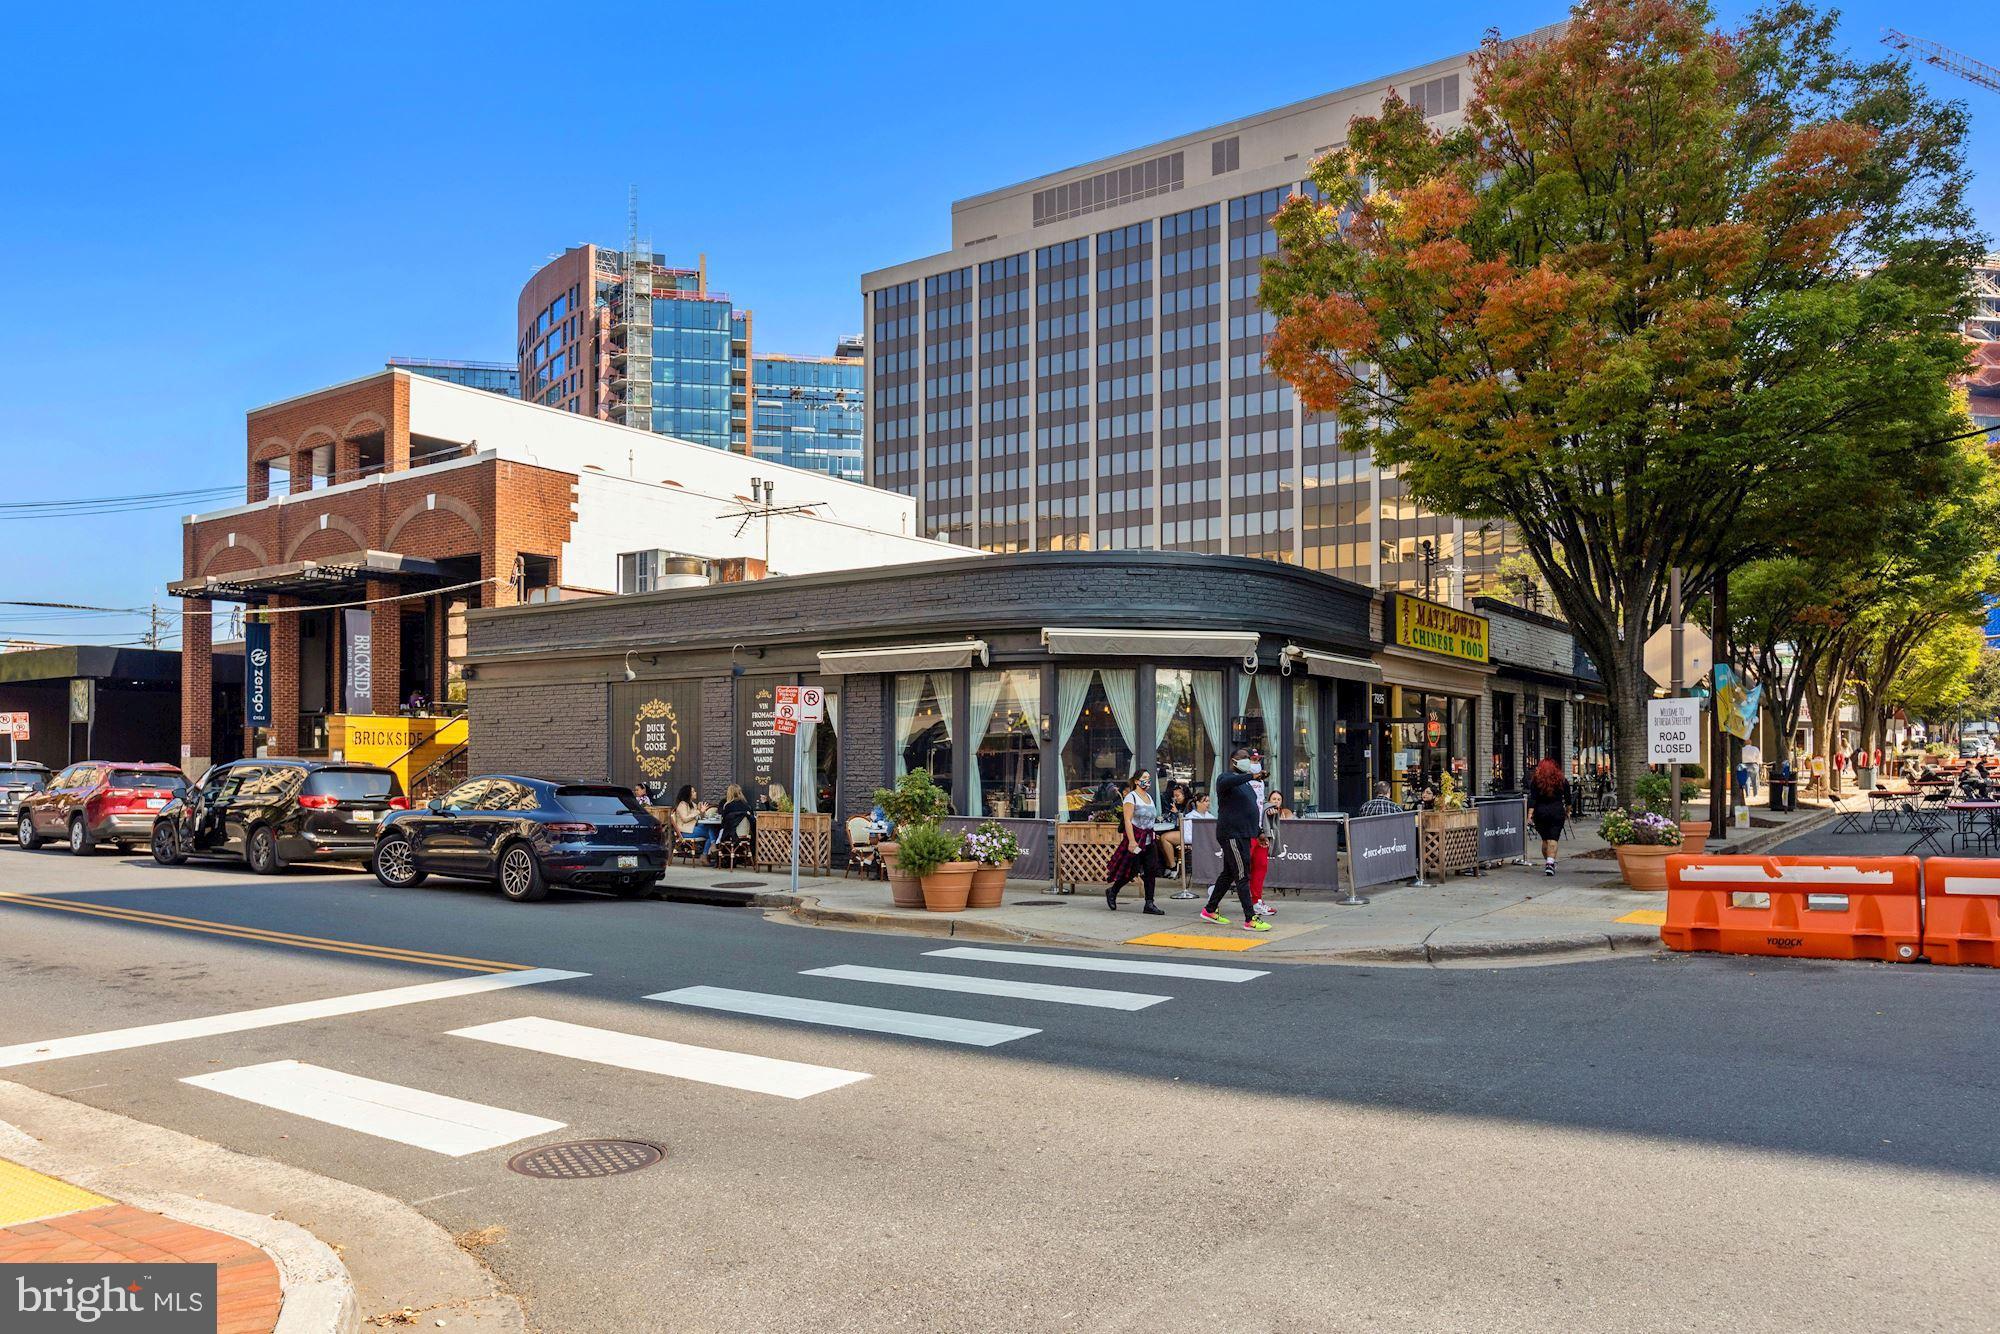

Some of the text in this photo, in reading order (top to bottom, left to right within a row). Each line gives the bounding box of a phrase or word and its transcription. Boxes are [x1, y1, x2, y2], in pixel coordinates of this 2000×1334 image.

[1416, 603, 1481, 640] MAYFLOWER
[1412, 628, 1483, 658] CHINESE FOOD
[354, 634, 370, 698] BRICKSIDE
[252, 669, 264, 713] zengo
[646, 724, 665, 732] DUCK
[646, 733, 665, 742] DUCK
[1659, 731, 1686, 741] ROAD
[644, 742, 667, 751] GOOSE
[1654, 743, 1692, 753] CLOSED
[1287, 853, 1312, 861] GOOSE
[1767, 936, 1803, 946] YODOCK
